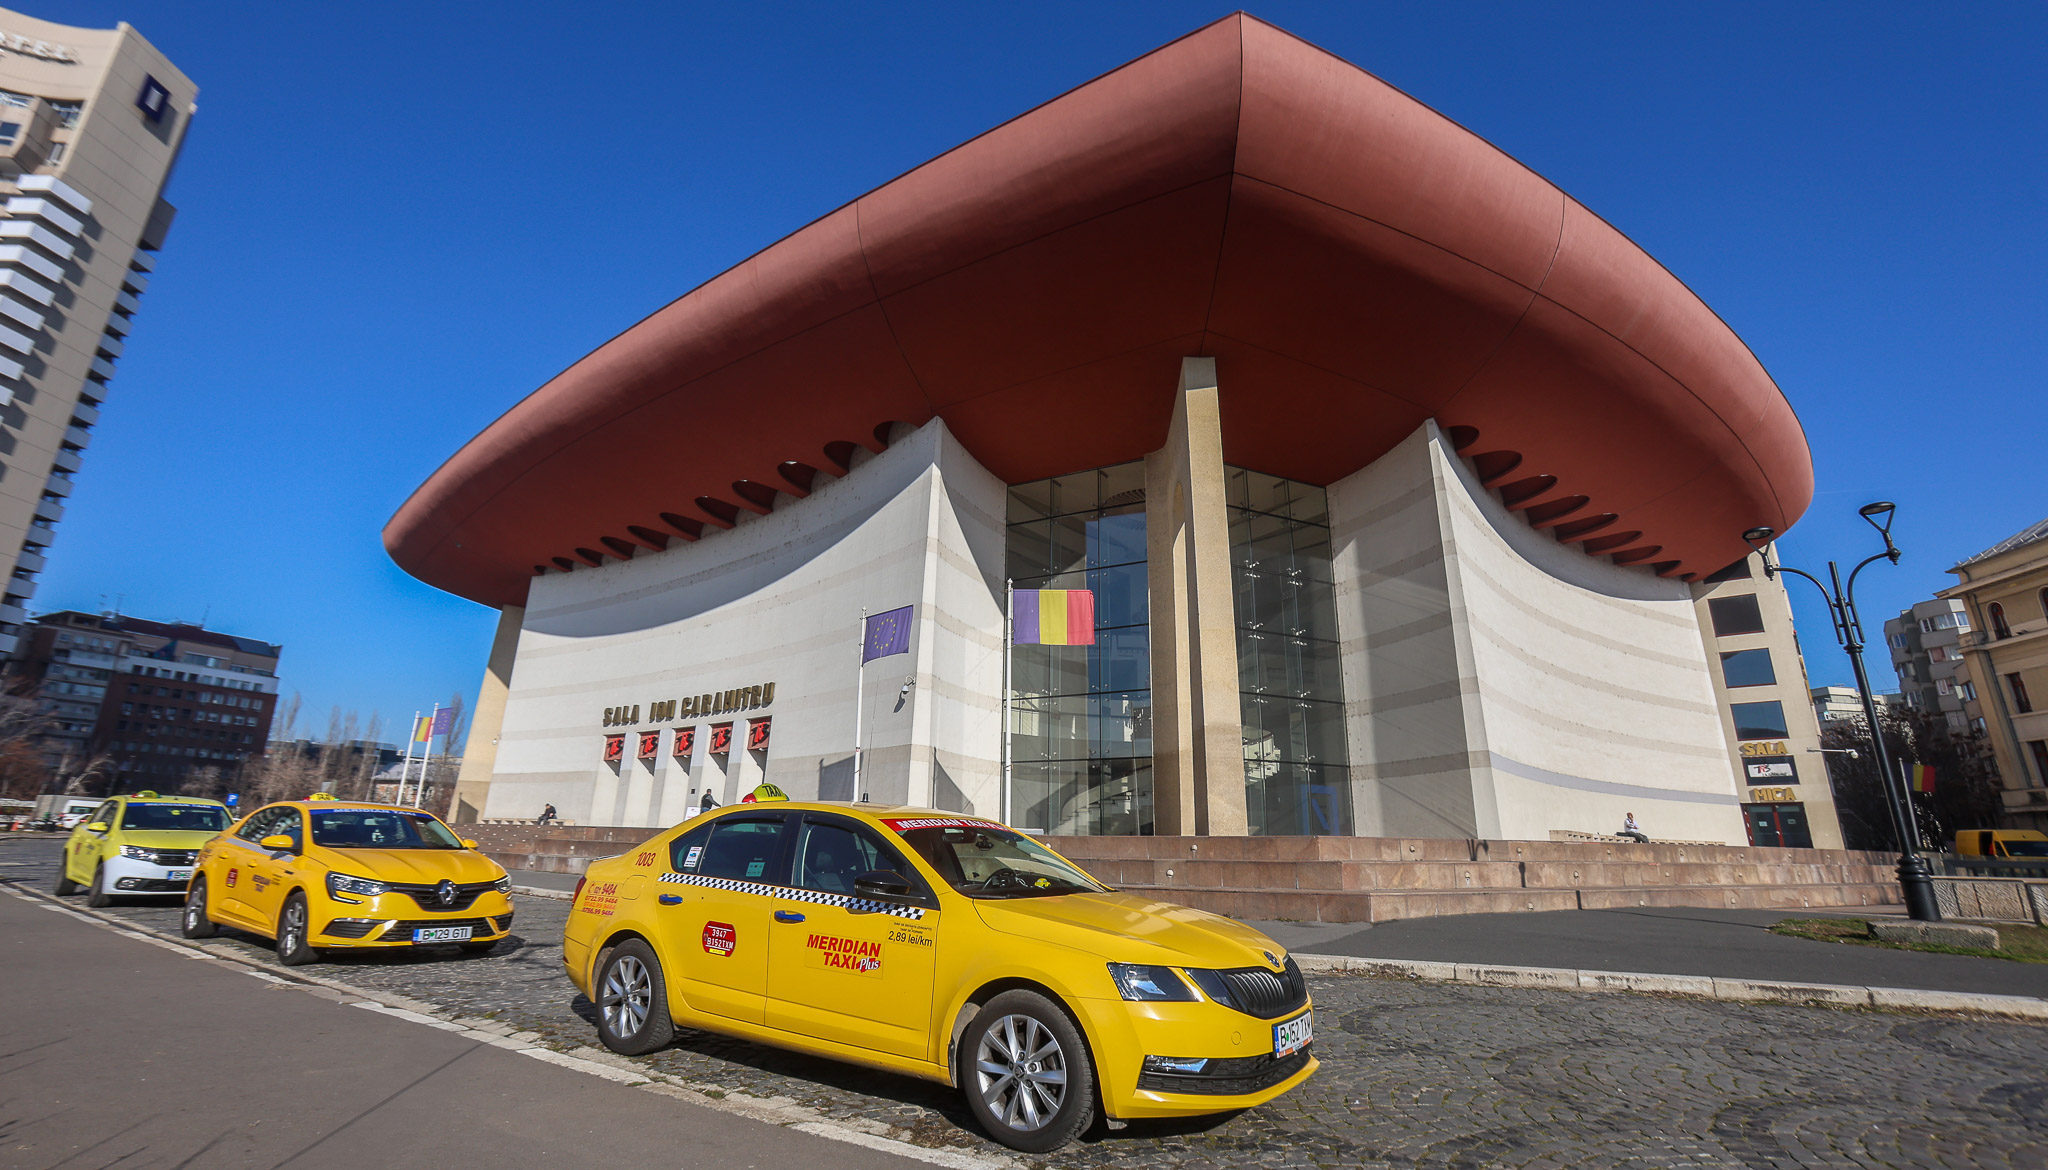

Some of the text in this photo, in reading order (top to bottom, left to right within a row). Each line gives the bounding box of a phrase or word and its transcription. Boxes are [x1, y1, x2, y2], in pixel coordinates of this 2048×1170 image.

[603, 704, 639, 726] SALA
[648, 699, 677, 723] ION
[1742, 741, 1788, 756] SALA
[761, 785, 782, 798] TAXI
[1752, 787, 1797, 801] MICA
[896, 818, 963, 829] MERIDIAN
[635, 851, 657, 867] 1003
[711, 928, 727, 939] 3947
[888, 930, 907, 943] 2,89
[907, 933, 933, 948] lei/km
[806, 934, 882, 958] MERIDIAN
[823, 951, 880, 971] TAXI Plus
